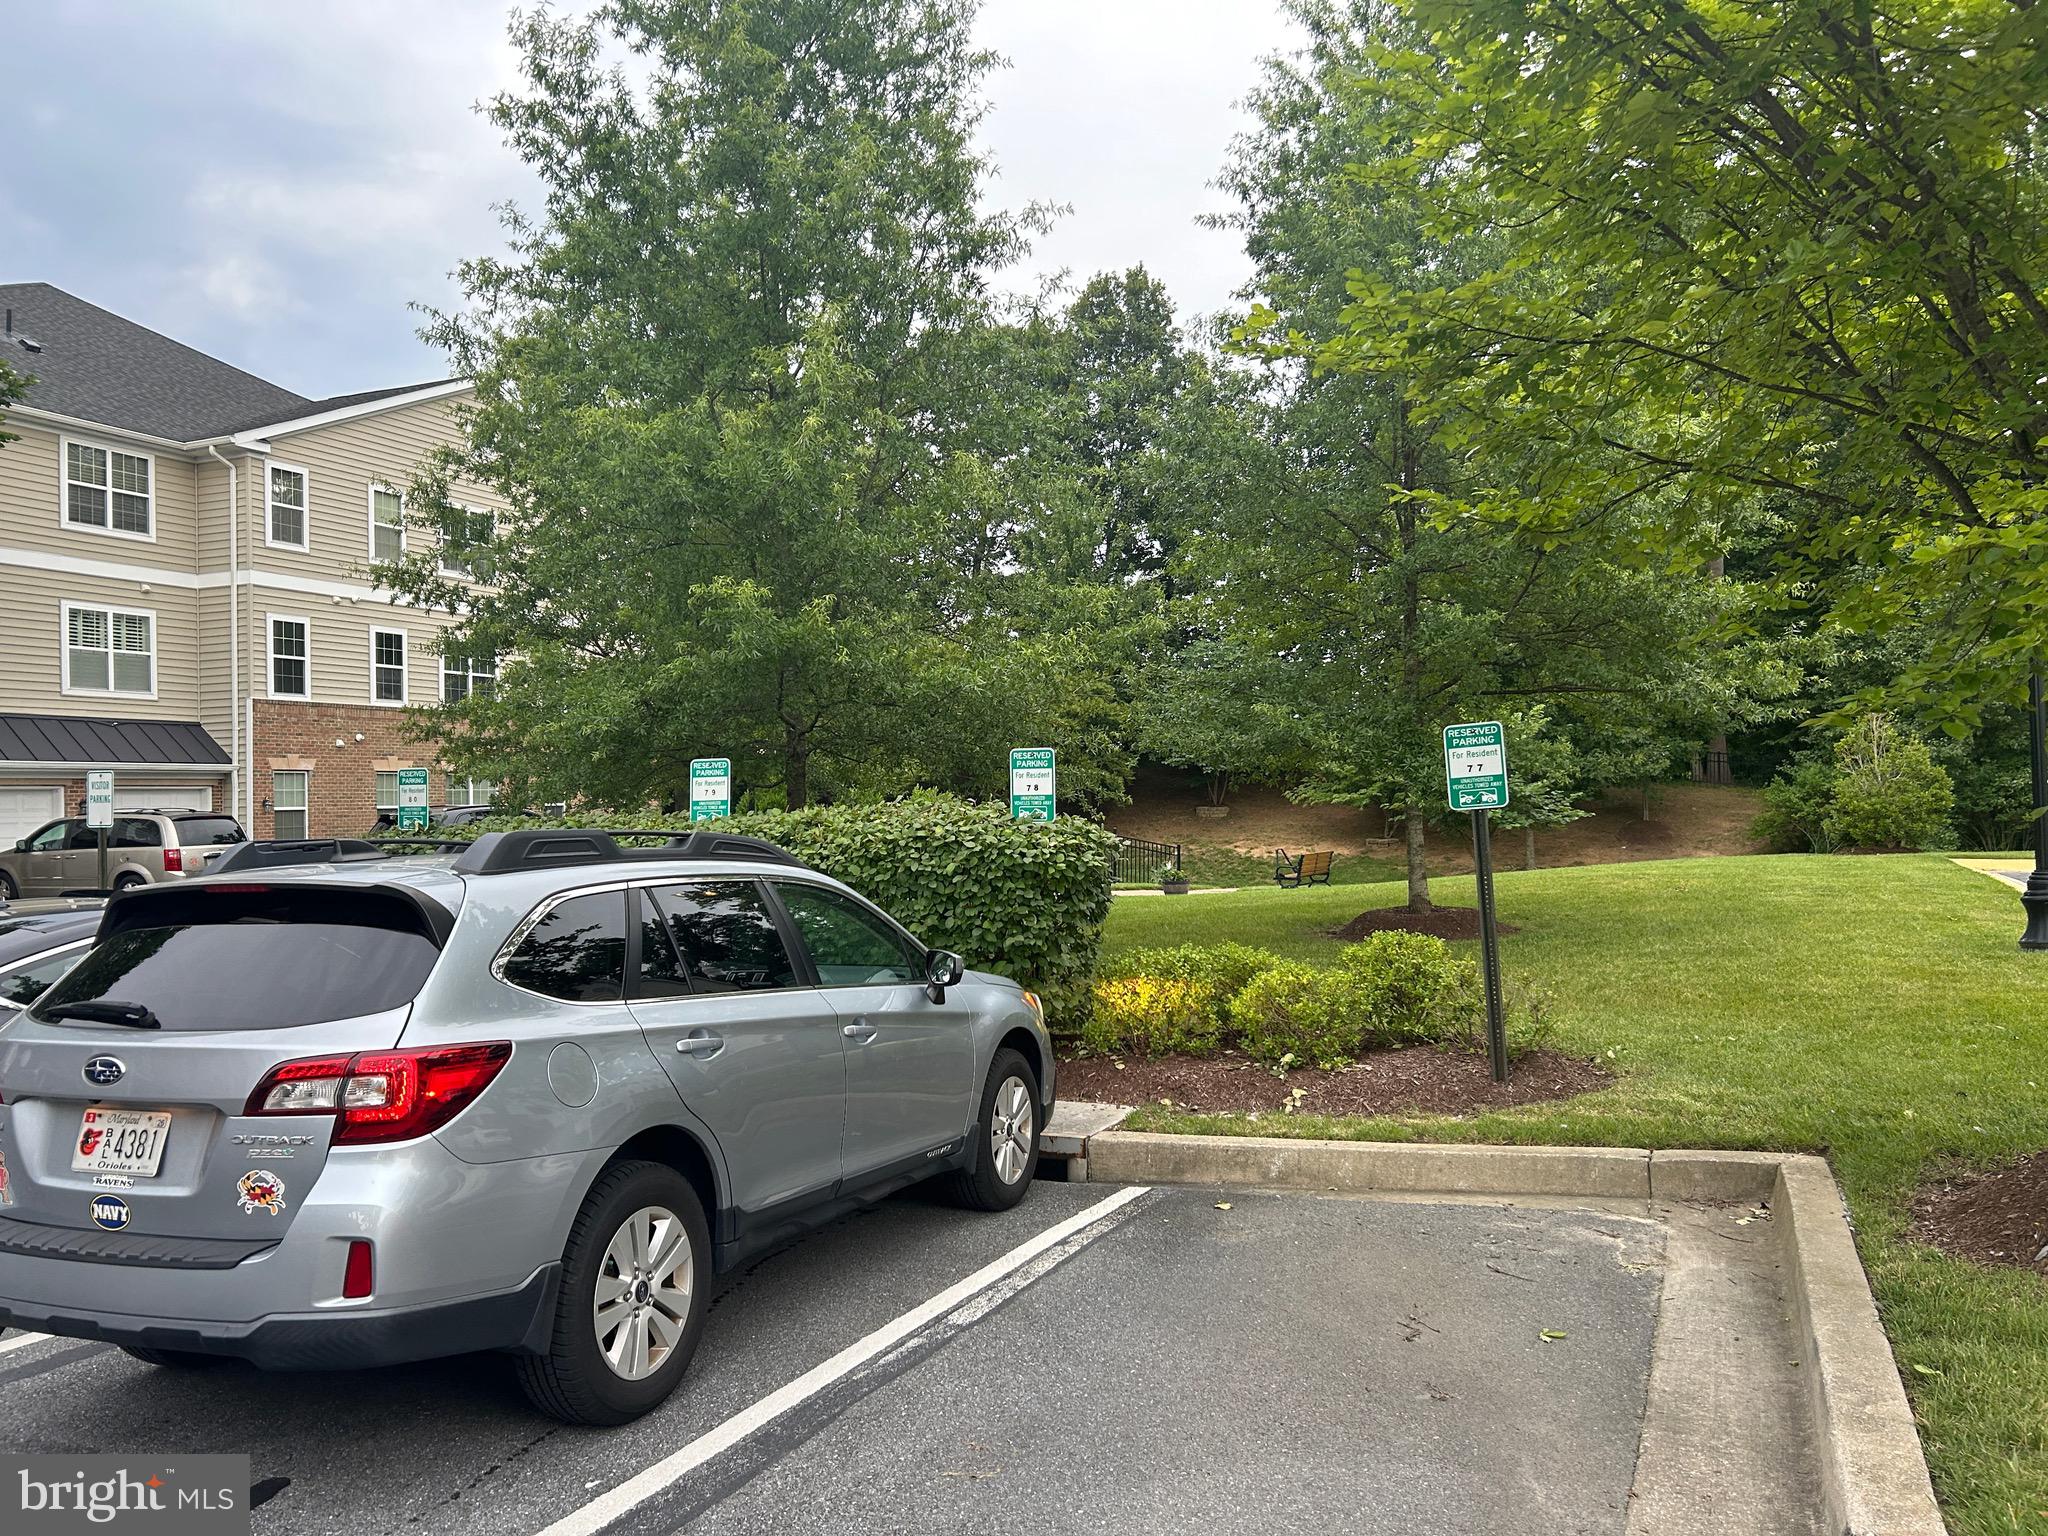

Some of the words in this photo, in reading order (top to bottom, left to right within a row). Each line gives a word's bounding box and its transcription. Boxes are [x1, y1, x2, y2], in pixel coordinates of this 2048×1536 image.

[1447, 725, 1498, 738] RESERVED
[1452, 735, 1495, 747] PARKING
[1013, 751, 1051, 760] RESERVED
[1452, 751, 1464, 759] For
[1466, 748, 1498, 759] Resident
[693, 761, 728, 769] RESERVED
[1026, 771, 1050, 779] Resident
[91, 781, 110, 790] VISITOR
[90, 794, 111, 803] PARKING
[114, 1128, 158, 1160] 4381
[231, 1134, 315, 1146] OUTBACK
[97, 1160, 132, 1171] Orioles
[95, 1176, 133, 1187] RAVENS
[92, 1203, 129, 1222] NAVY
